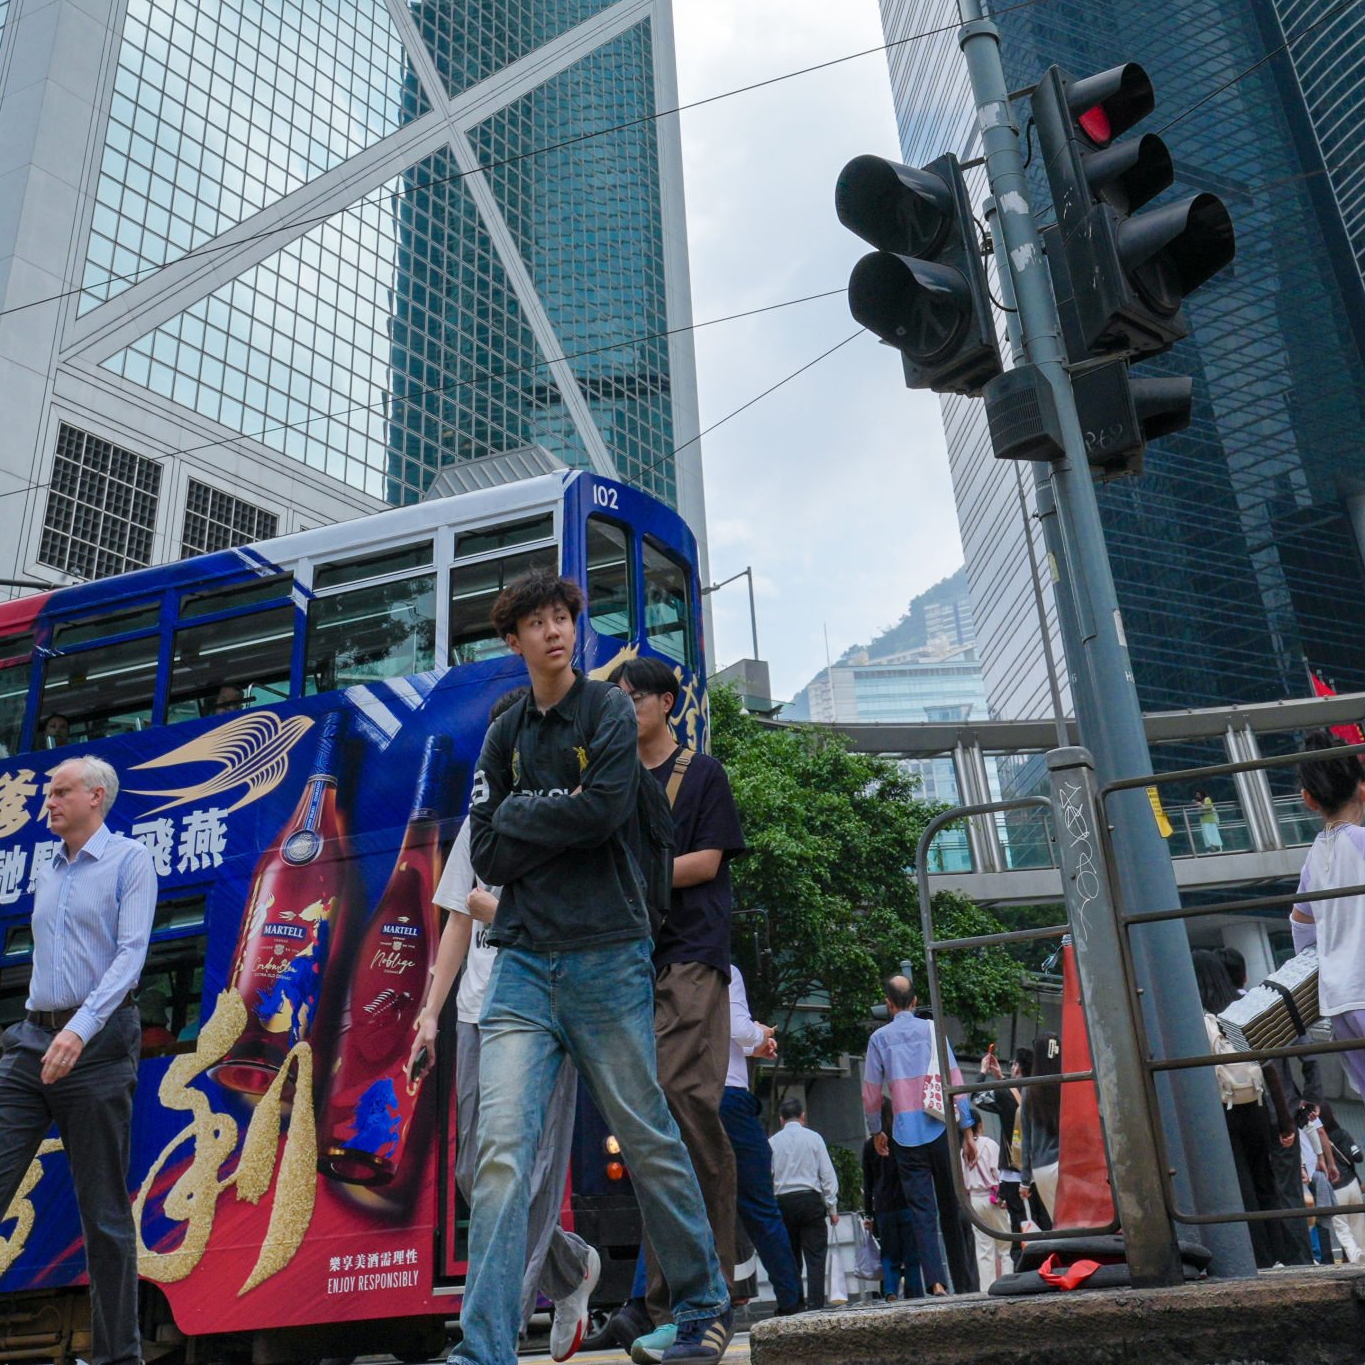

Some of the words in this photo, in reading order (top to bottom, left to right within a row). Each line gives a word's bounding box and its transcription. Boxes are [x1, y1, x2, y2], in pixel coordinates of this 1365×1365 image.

[593, 484, 619, 510] 102
[263, 925, 305, 939] MARTELL
[382, 925, 418, 936] MARTELL
[329, 1248, 419, 1272] 樂享美酒需理性
[327, 1277, 356, 1295] ENJOY
[358, 1270, 419, 1291] RESPONSIBLY
